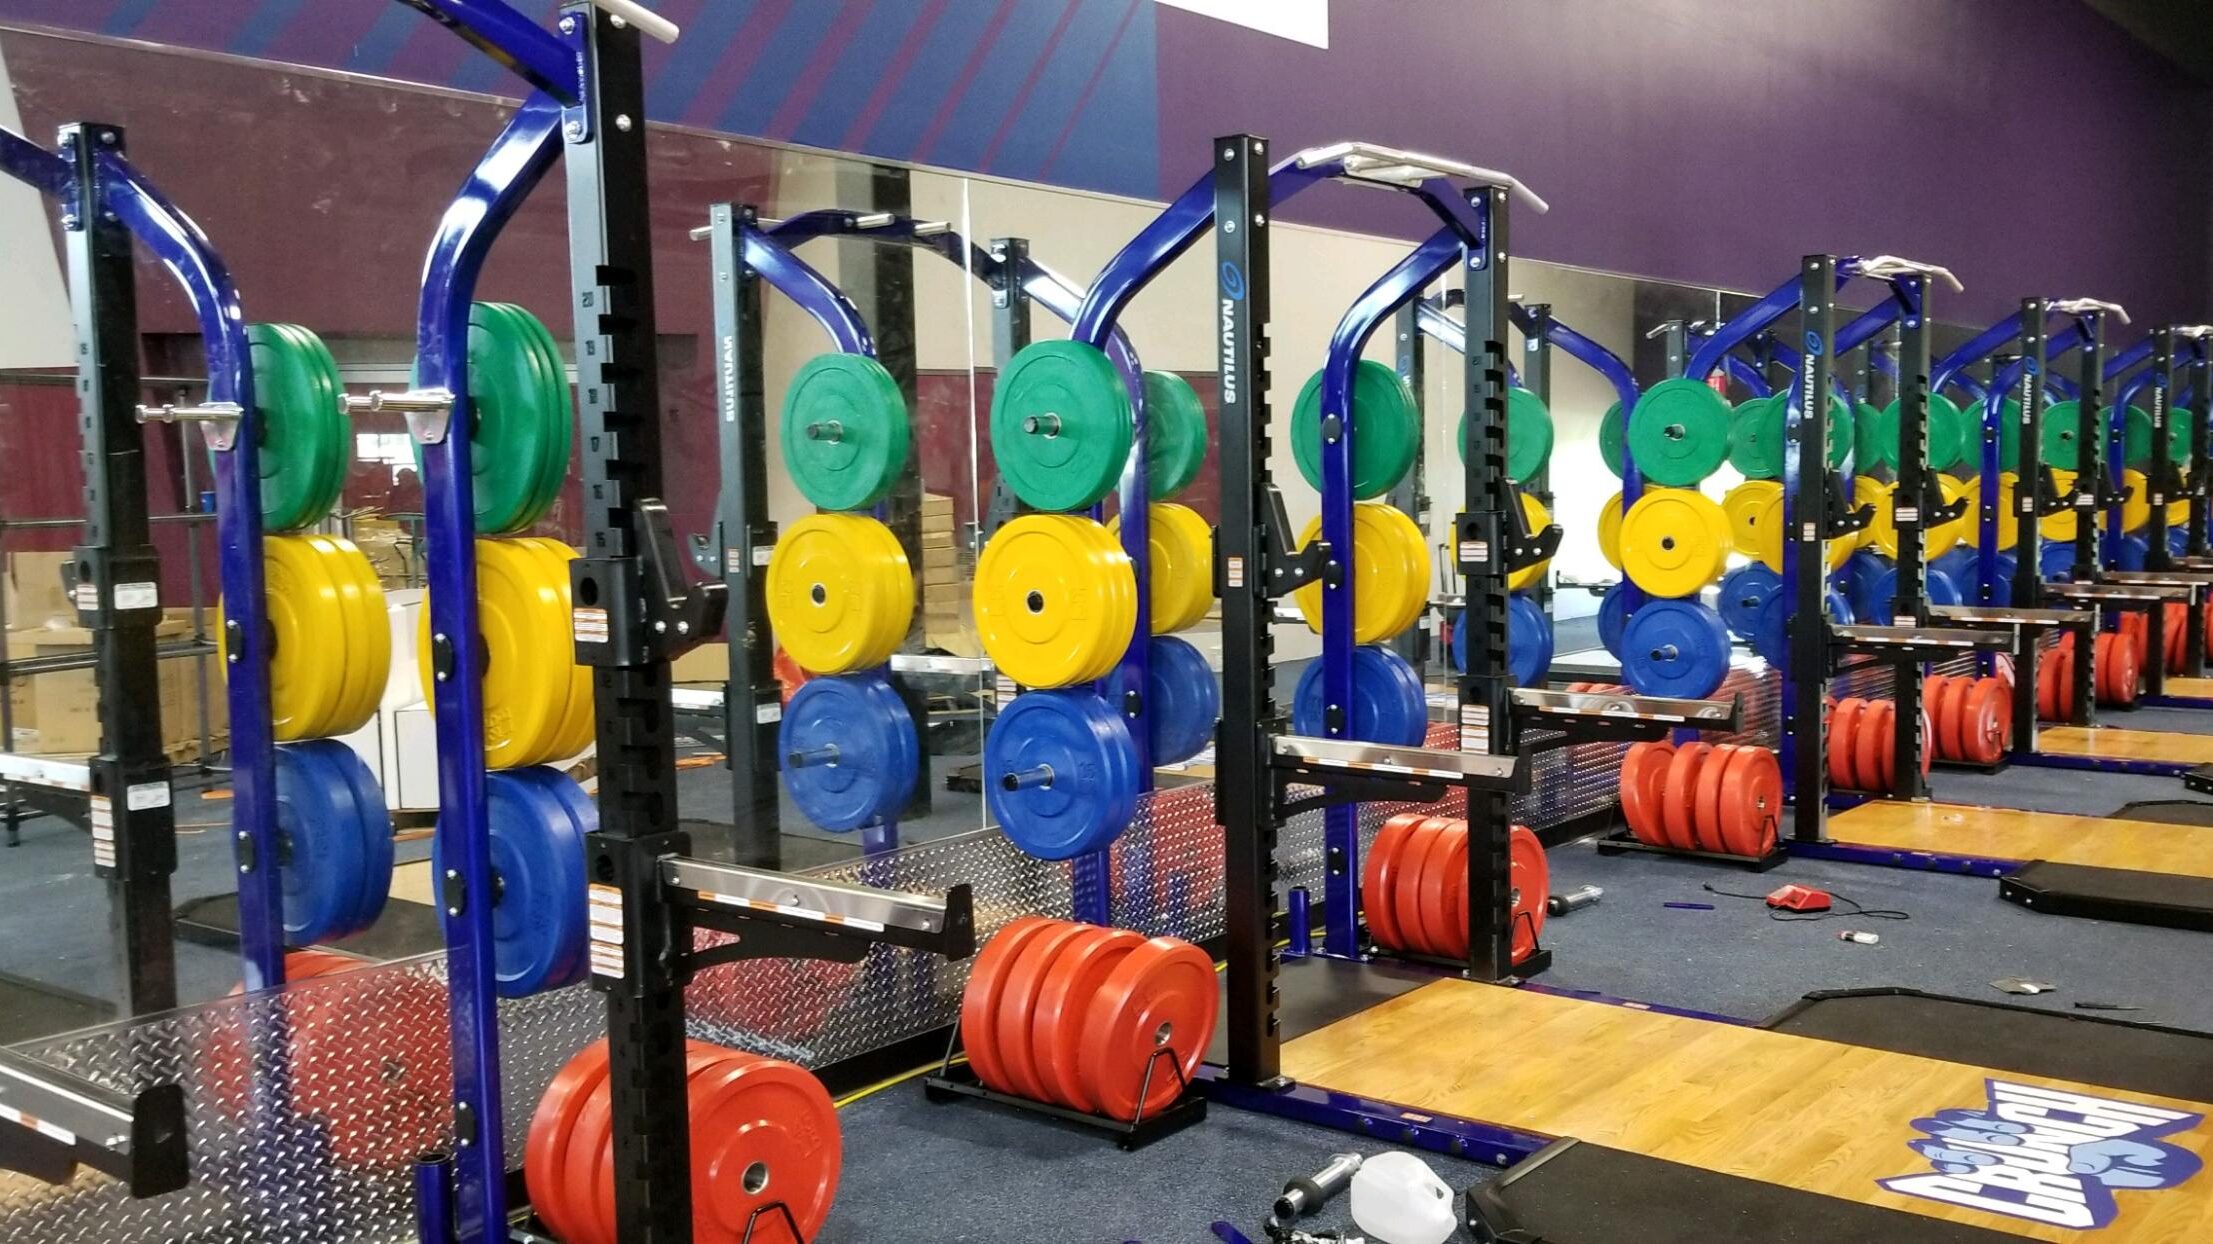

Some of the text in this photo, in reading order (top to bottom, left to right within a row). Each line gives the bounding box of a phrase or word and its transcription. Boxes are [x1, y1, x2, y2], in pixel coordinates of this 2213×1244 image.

[582, 291, 594, 308] 20
[1222, 299, 1236, 404] NAUTILUS
[1804, 354, 1815, 419] NAUTILUS
[2022, 373, 2032, 425] NAUTILUS
[2153, 386, 2163, 429] NAUTILUS
[1884, 1080, 2195, 1226] CRUNCH
